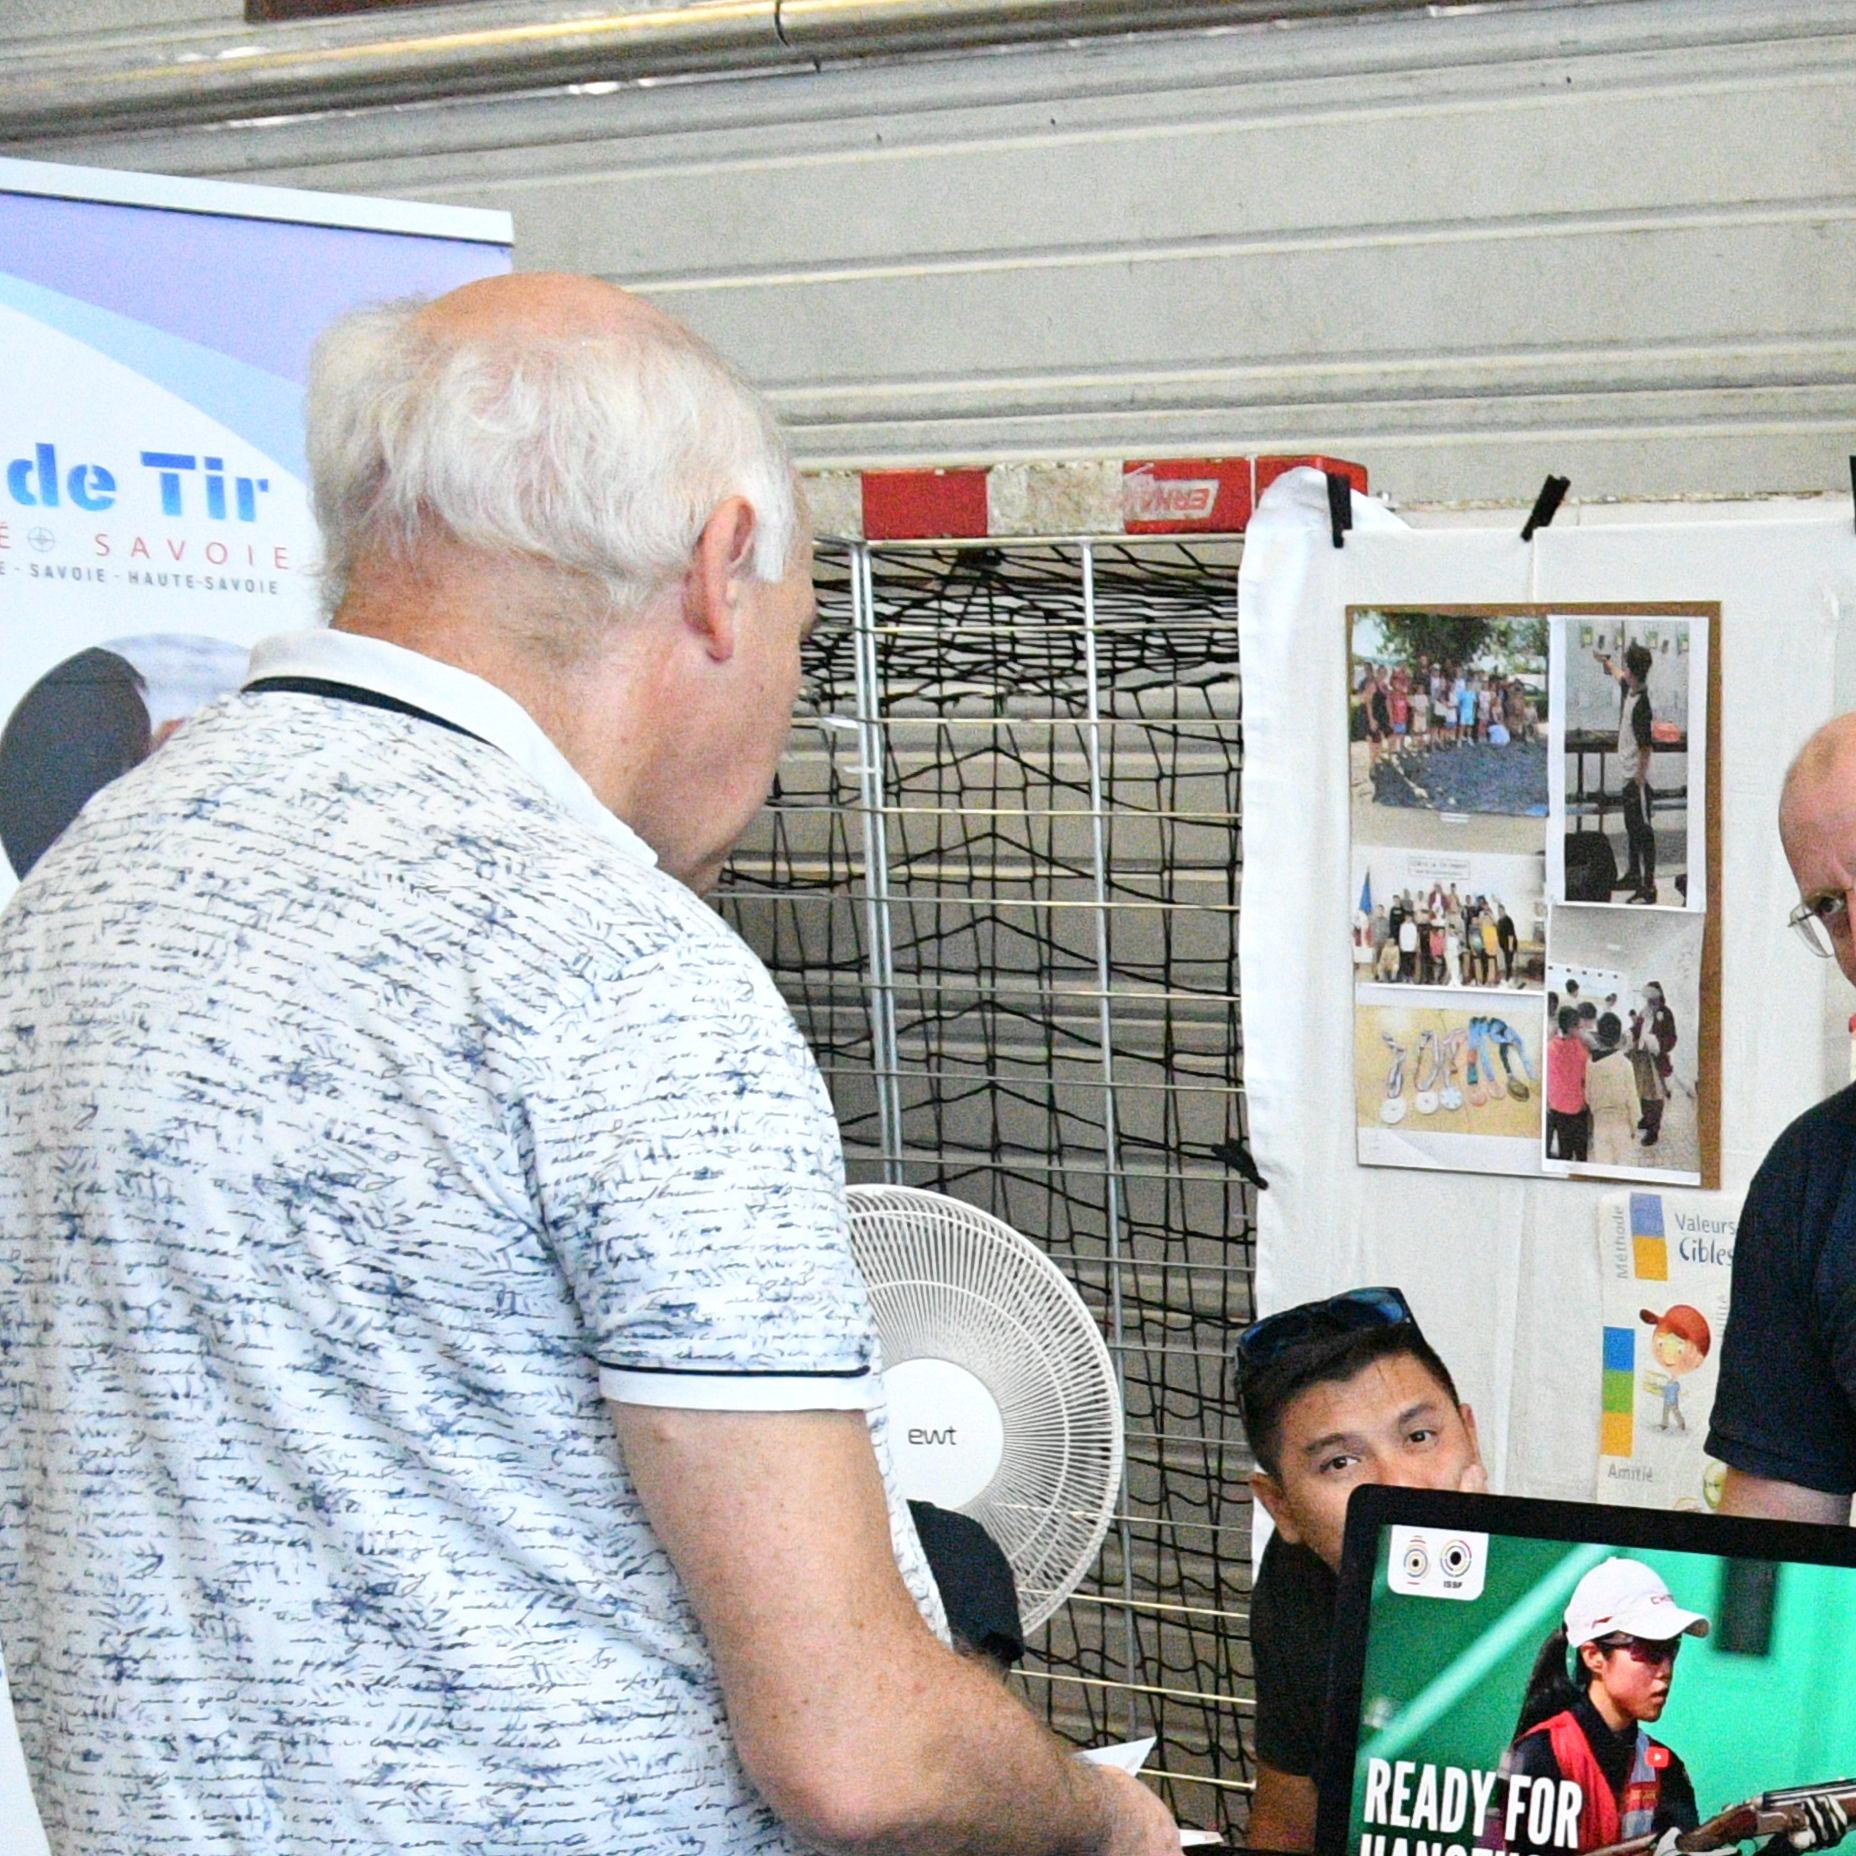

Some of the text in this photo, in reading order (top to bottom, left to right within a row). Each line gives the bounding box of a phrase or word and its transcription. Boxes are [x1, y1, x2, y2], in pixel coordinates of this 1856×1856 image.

[7, 442, 269, 522] de Tir
[94, 533, 290, 570] SAVOIE
[30, 564, 278, 595] SAVOIE HAUTE-SAVOIE
[1675, 1213, 1736, 1235] Valeurs
[1610, 1205, 1627, 1279] Méthode
[1679, 1236, 1734, 1266] Cibles
[908, 1425, 957, 1446] ewt
[1608, 1463, 1653, 1483] Amitié
[1364, 1757, 1584, 1848] READY FOR
